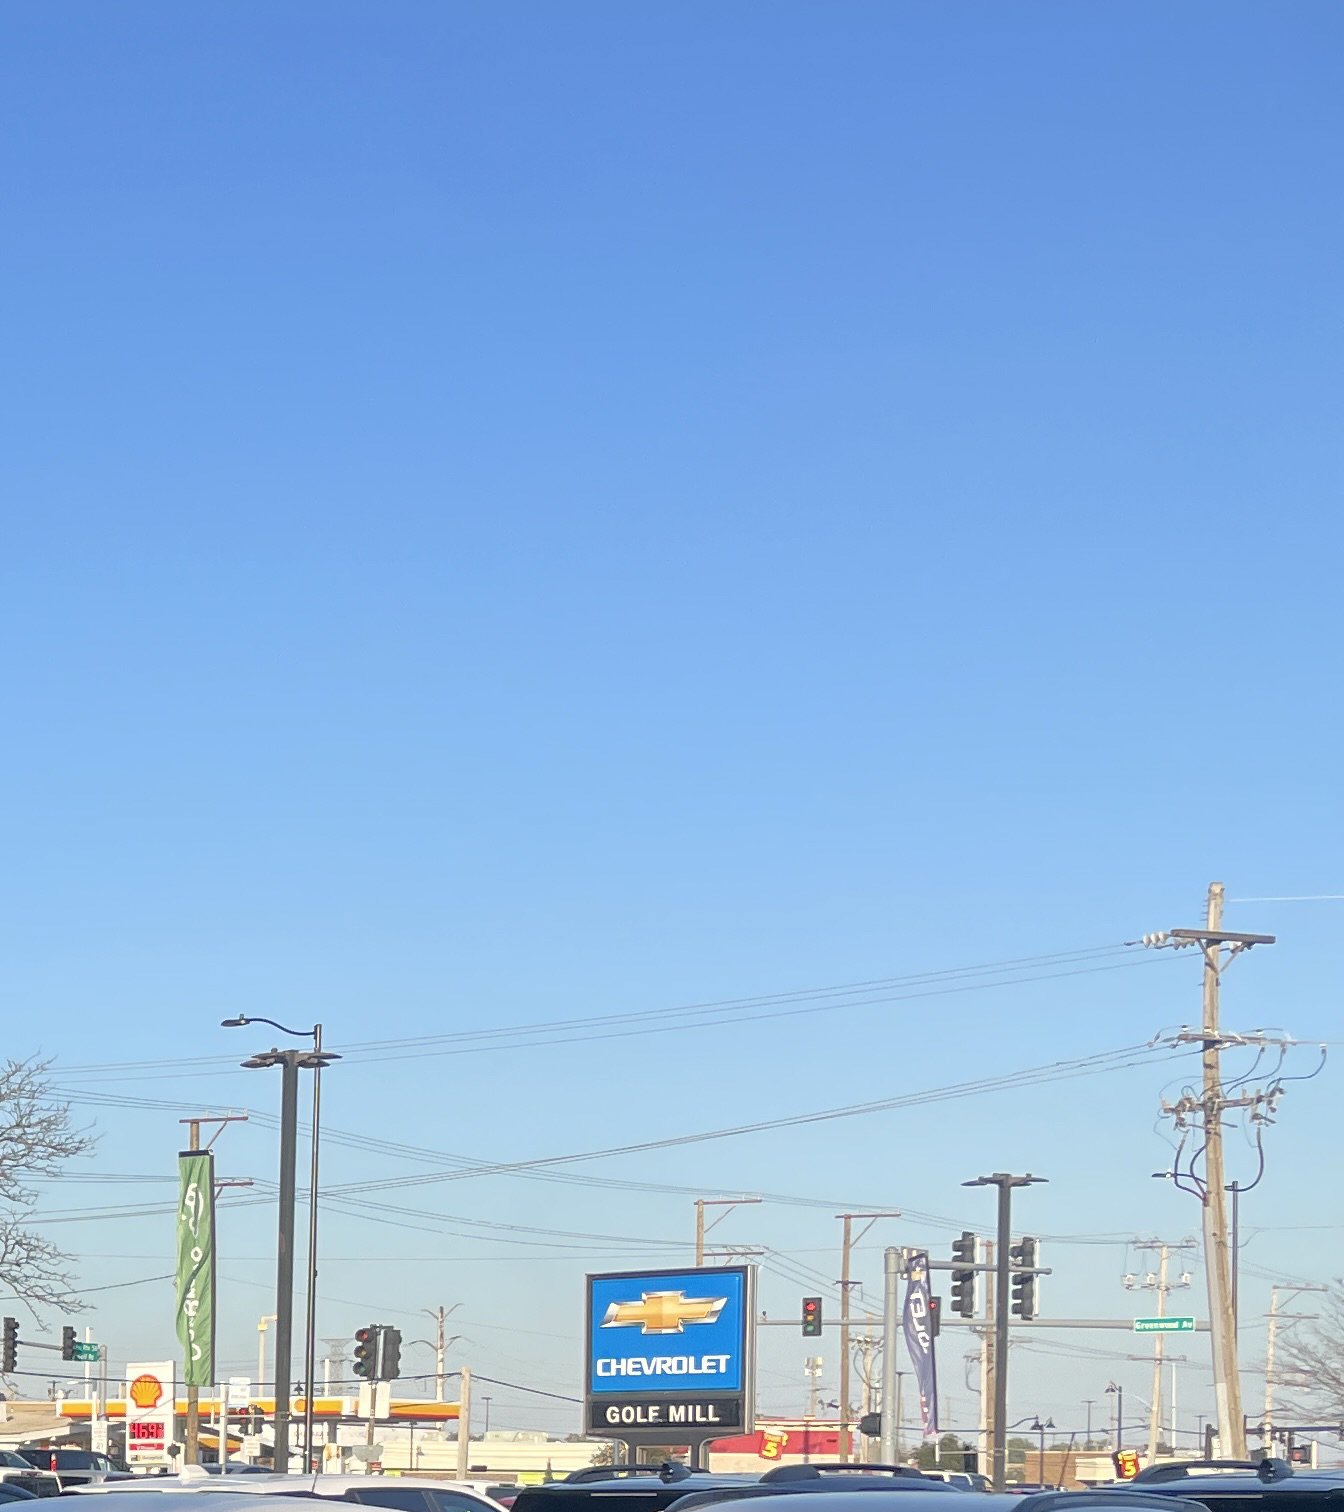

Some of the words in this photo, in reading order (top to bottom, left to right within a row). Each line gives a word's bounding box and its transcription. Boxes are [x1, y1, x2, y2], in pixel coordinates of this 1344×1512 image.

[596, 1355, 731, 1377] CHEVROLET
[606, 1406, 660, 1423] GOLF
[668, 1404, 720, 1422] MILL
